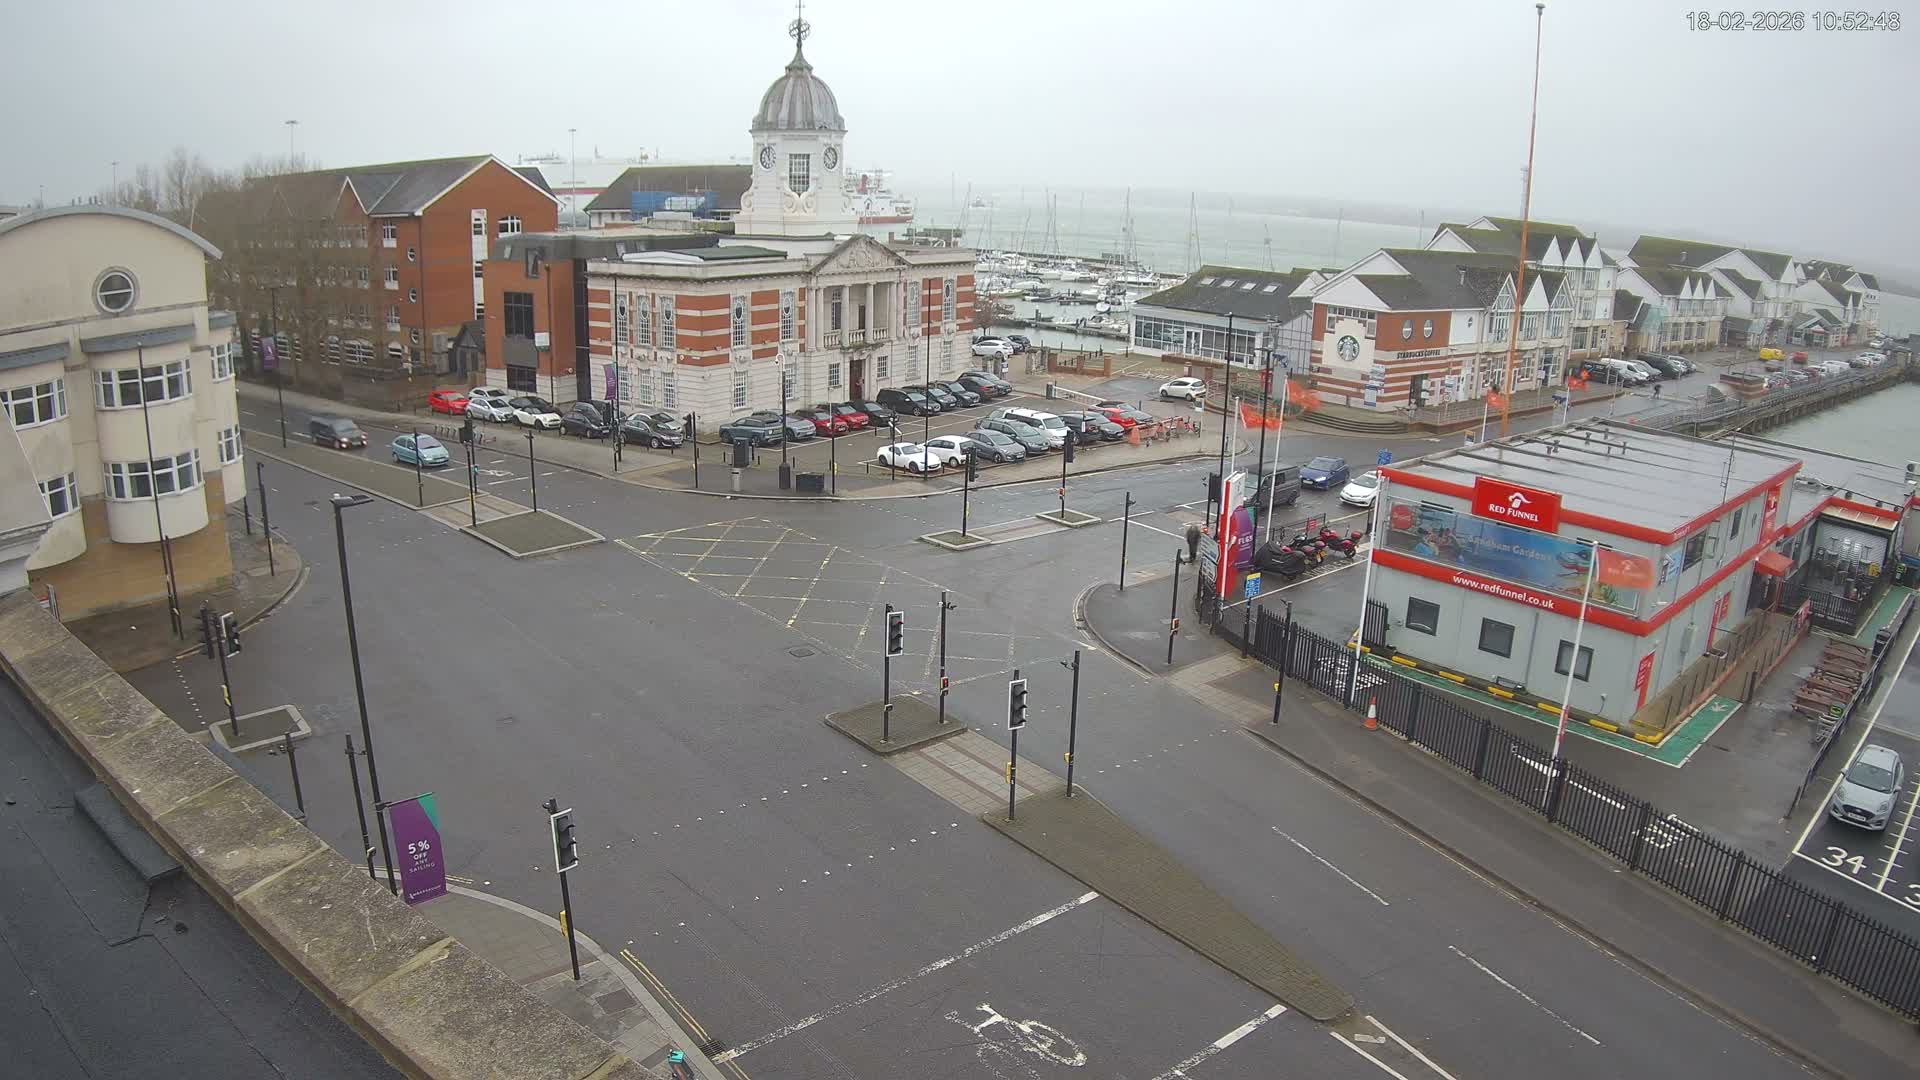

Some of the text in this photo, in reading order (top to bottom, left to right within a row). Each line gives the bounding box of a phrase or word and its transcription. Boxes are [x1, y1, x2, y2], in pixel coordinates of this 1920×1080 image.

[1488, 503, 1539, 523] RED FUNNEL
[1452, 575, 1555, 610] www.redfunnel.co.uk
[413, 852, 427, 860] OFF
[1821, 846, 1867, 875] 34
